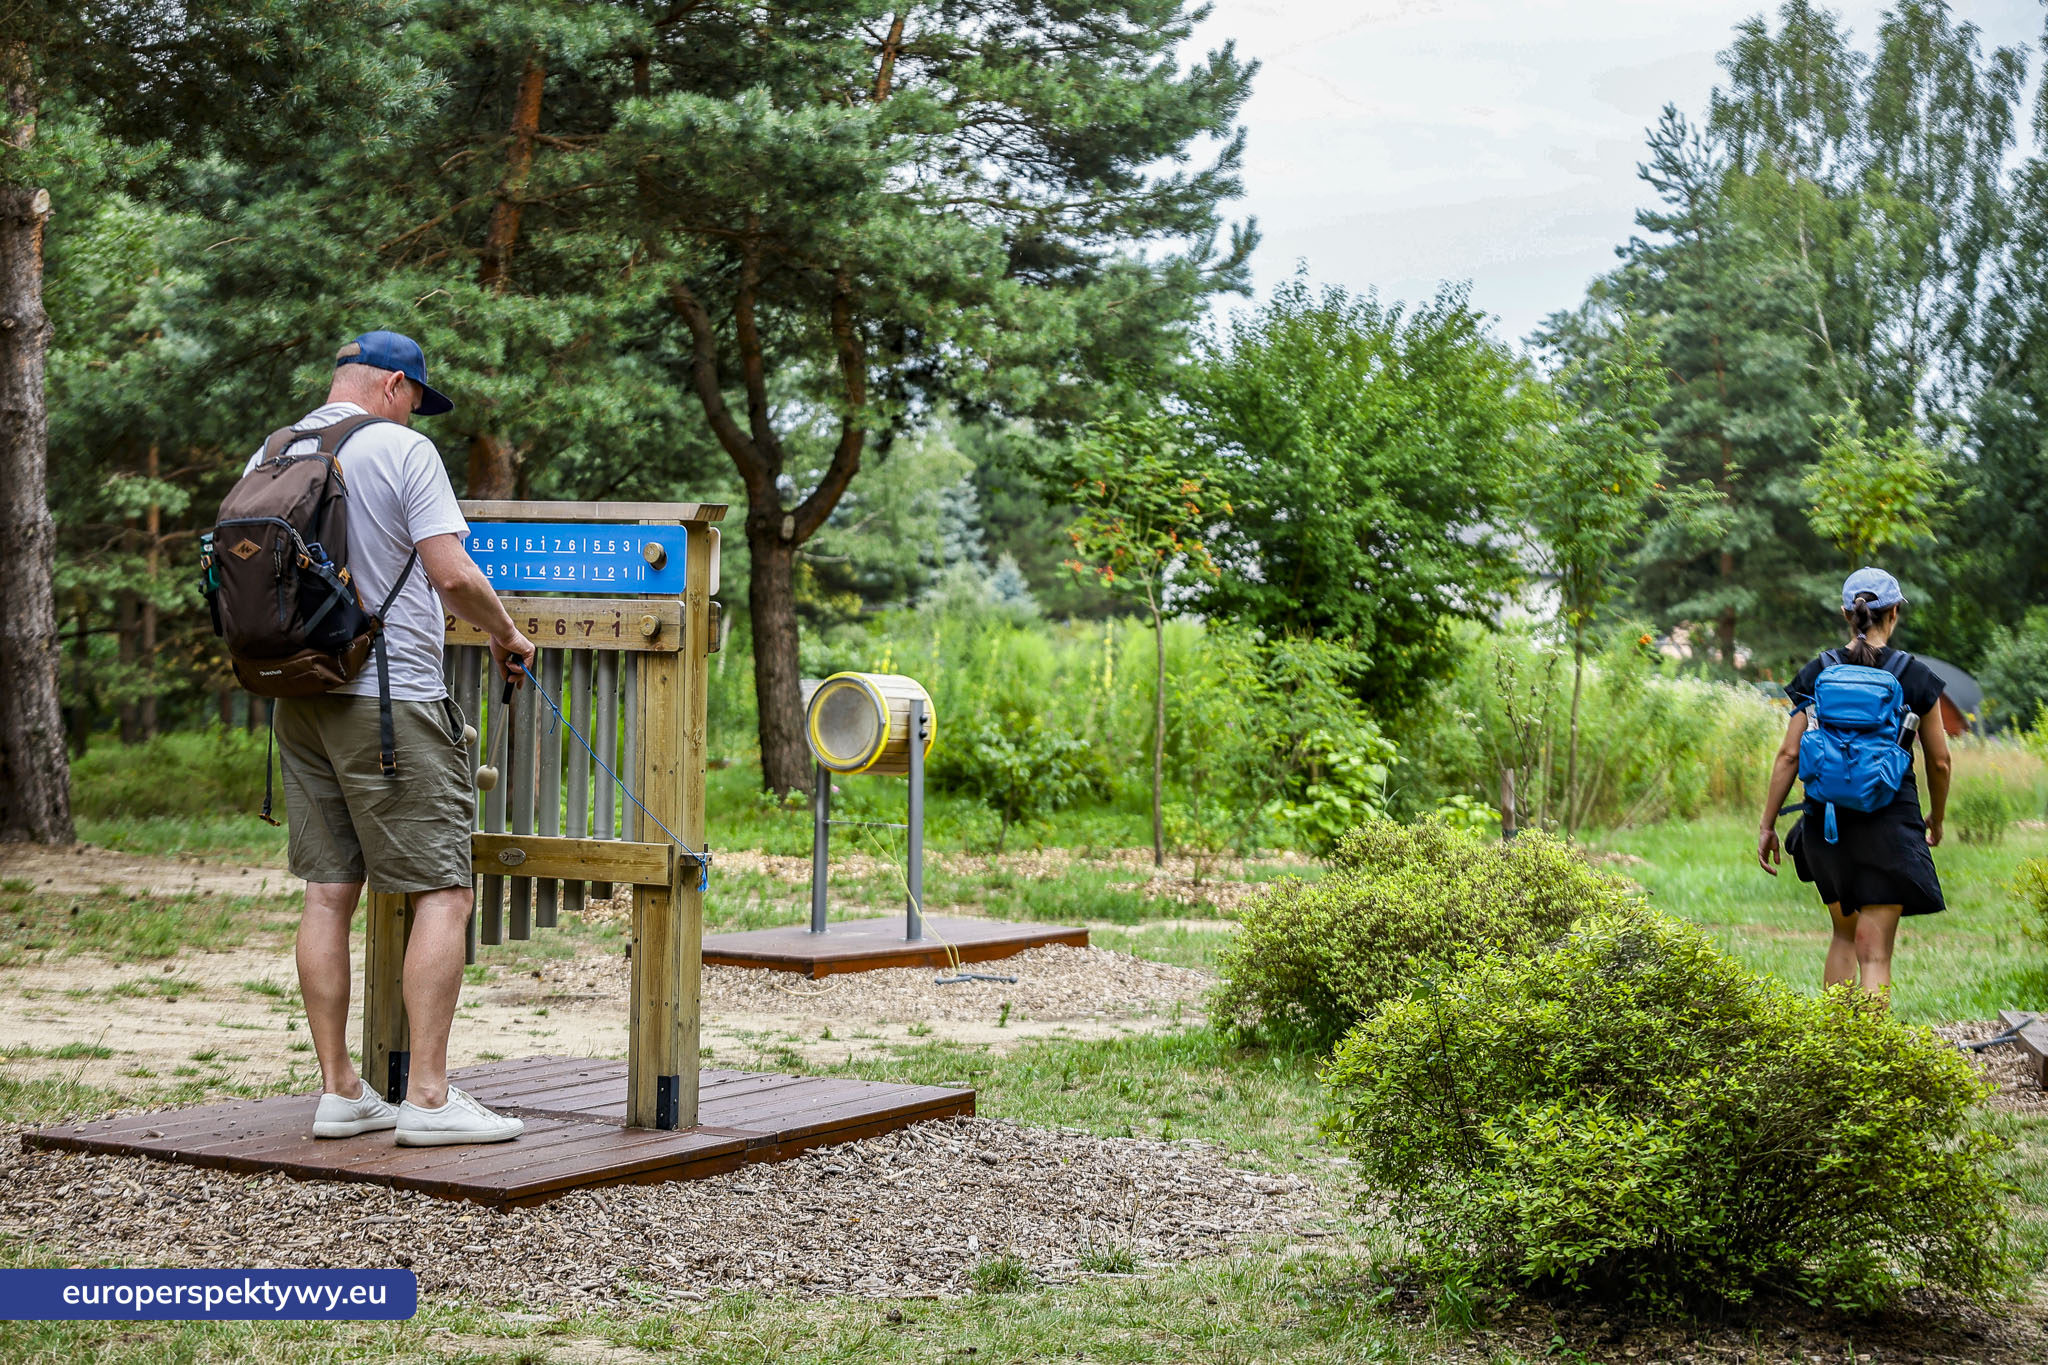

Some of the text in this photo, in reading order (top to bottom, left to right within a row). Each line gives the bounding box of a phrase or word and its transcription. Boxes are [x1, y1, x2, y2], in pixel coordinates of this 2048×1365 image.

[473, 538, 480, 549] 5
[487, 538, 494, 550] 6
[501, 538, 508, 550] 5
[525, 538, 533, 551] 5
[555, 539, 561, 551] 7
[568, 539, 576, 551] 6
[593, 540, 601, 552] 5
[608, 540, 616, 552] 5
[623, 540, 630, 552] 3
[486, 564, 629, 579] 5 3 1 4 3 2 1 2 1
[445, 615, 457, 632] 2
[527, 618, 539, 635] 5
[555, 618, 567, 636] 6
[583, 620, 595, 637] 7
